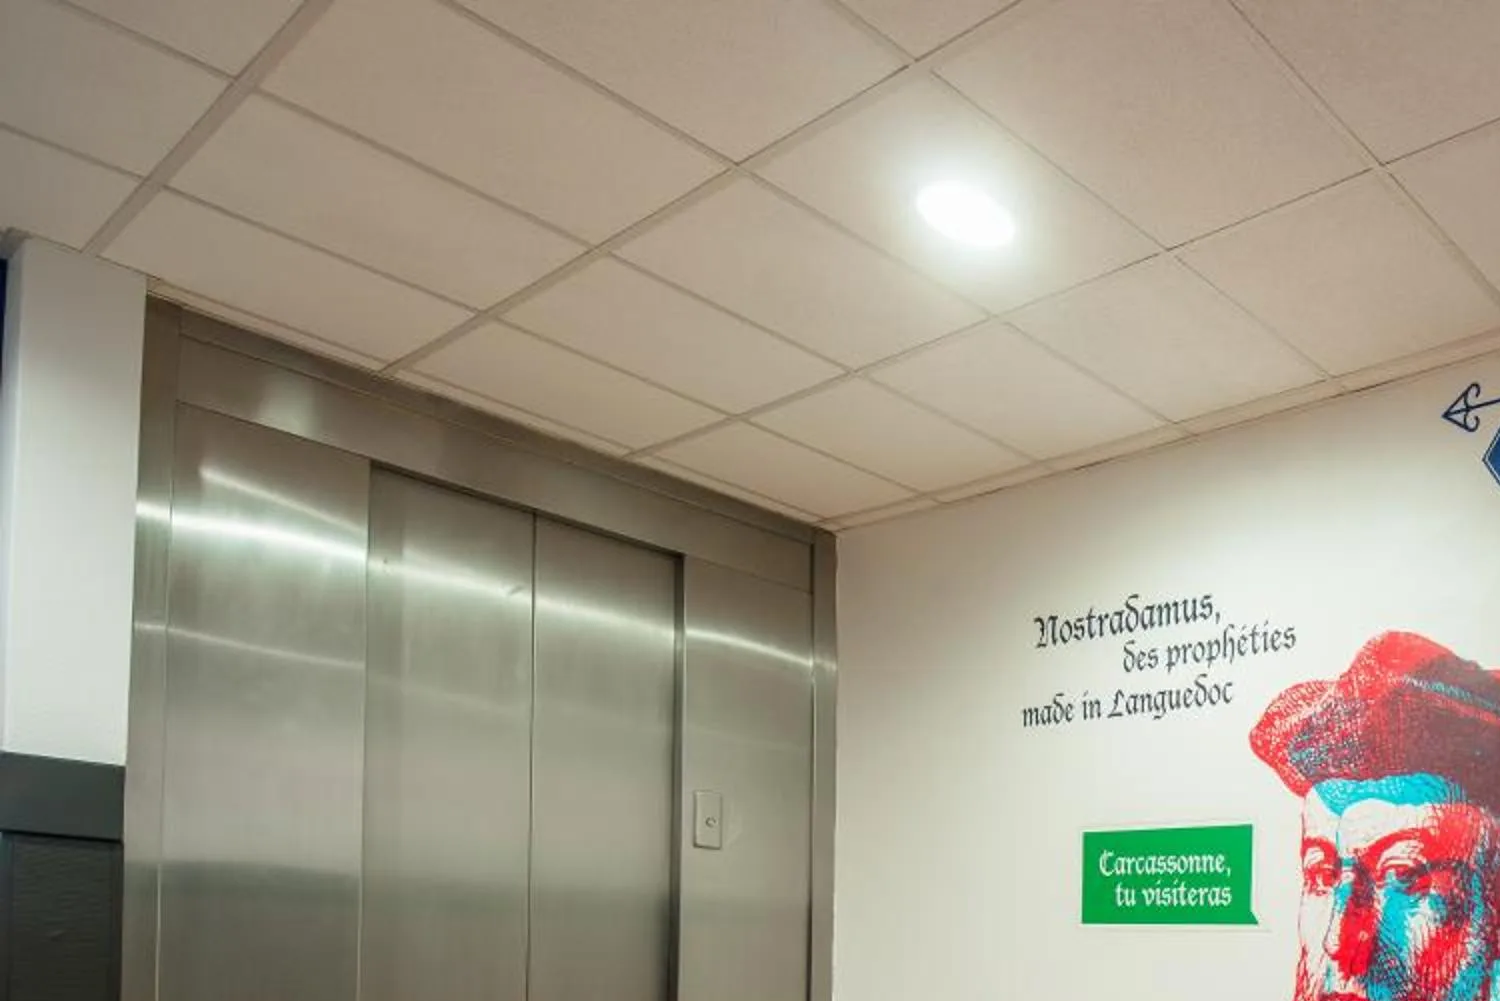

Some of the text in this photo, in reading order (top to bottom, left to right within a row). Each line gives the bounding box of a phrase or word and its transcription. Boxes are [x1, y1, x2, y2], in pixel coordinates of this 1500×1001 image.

[1033, 593, 1221, 650] Nostradamus,
[1122, 619, 1297, 673] des prophéties
[1022, 673, 1234, 728] made in Languedoc
[1099, 849, 1232, 877] Carcassonne,
[1114, 878, 1233, 908] tu visiteras
